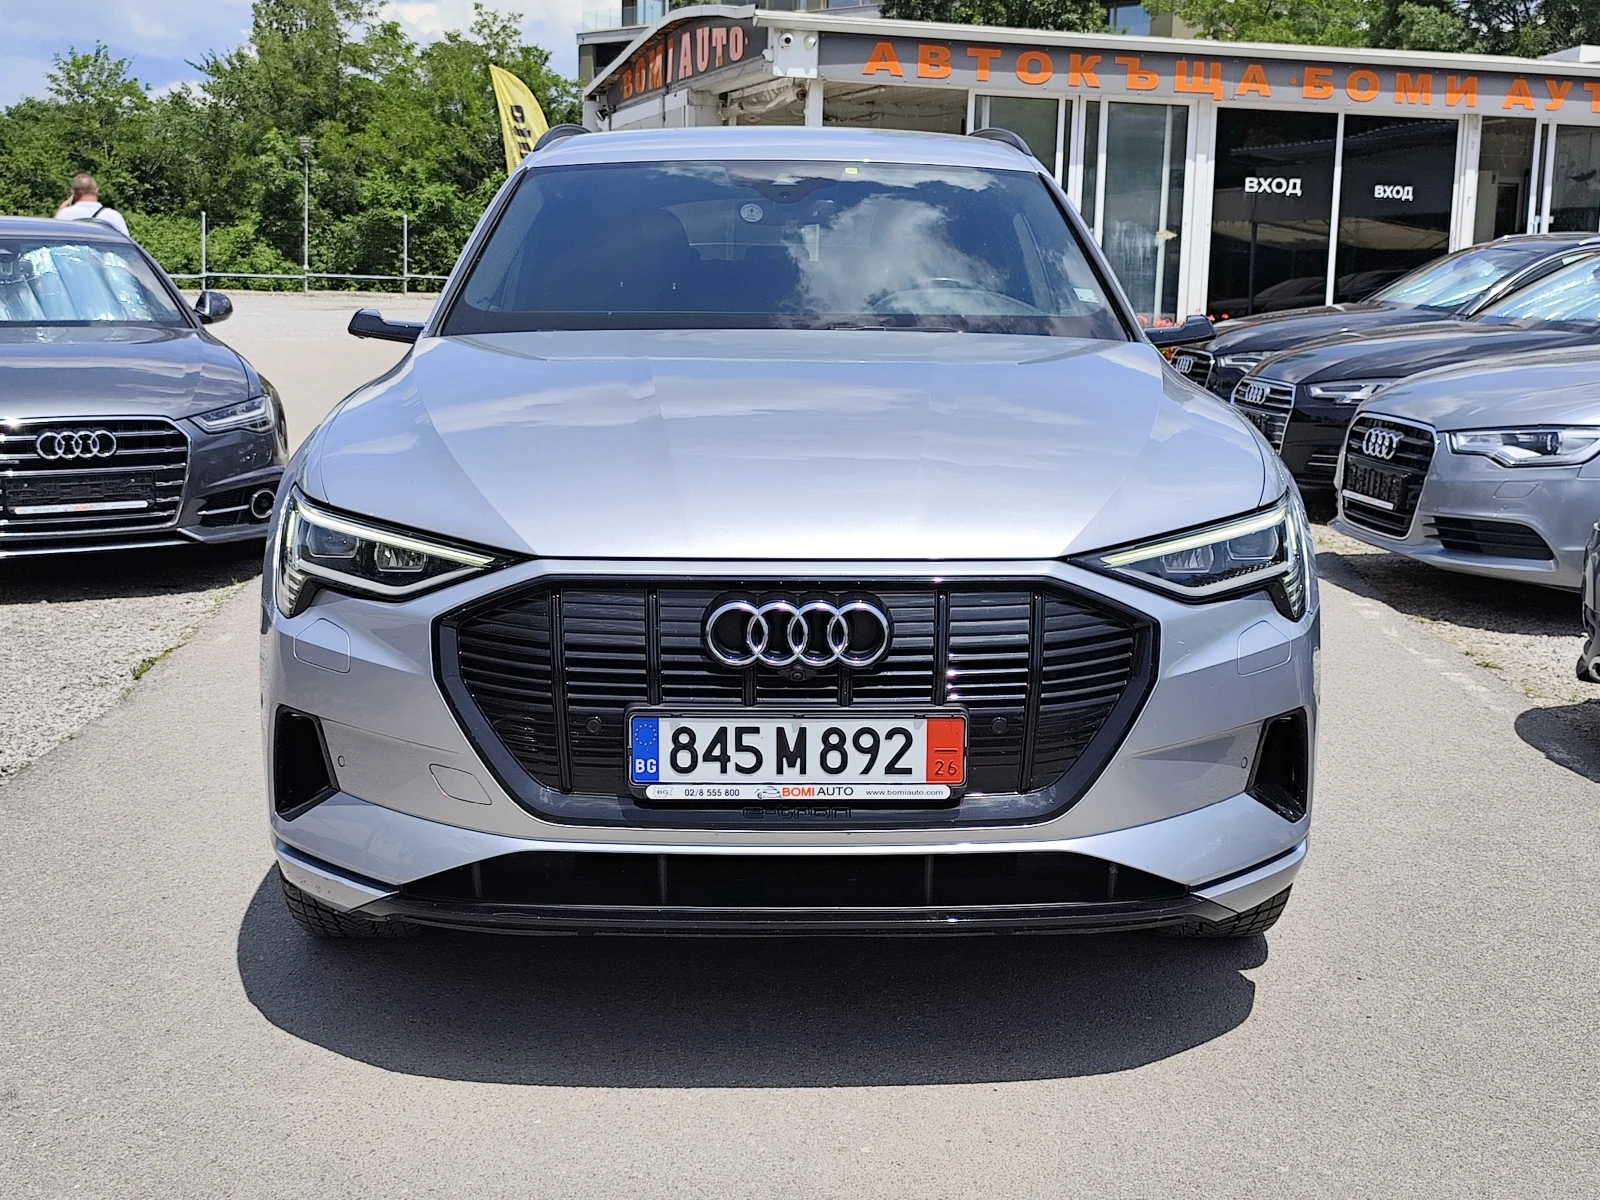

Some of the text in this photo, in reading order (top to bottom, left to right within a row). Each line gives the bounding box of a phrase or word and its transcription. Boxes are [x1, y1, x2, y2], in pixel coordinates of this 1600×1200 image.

[678, 26, 744, 81] AUTO
[862, 41, 1271, 101] АВТОКЪЩА
[1302, 66, 1478, 107] БОМИ
[1244, 176, 1303, 197] ВХОД
[1374, 184, 1414, 201] ВХОД
[635, 758, 657, 774] BG
[934, 759, 958, 777] 26
[684, 788, 740, 797] 02/8 555 800
[782, 786, 854, 797] BOMI AUTO
[865, 788, 944, 797] www.bomiauto.com
[742, 804, 852, 819] e-tron
